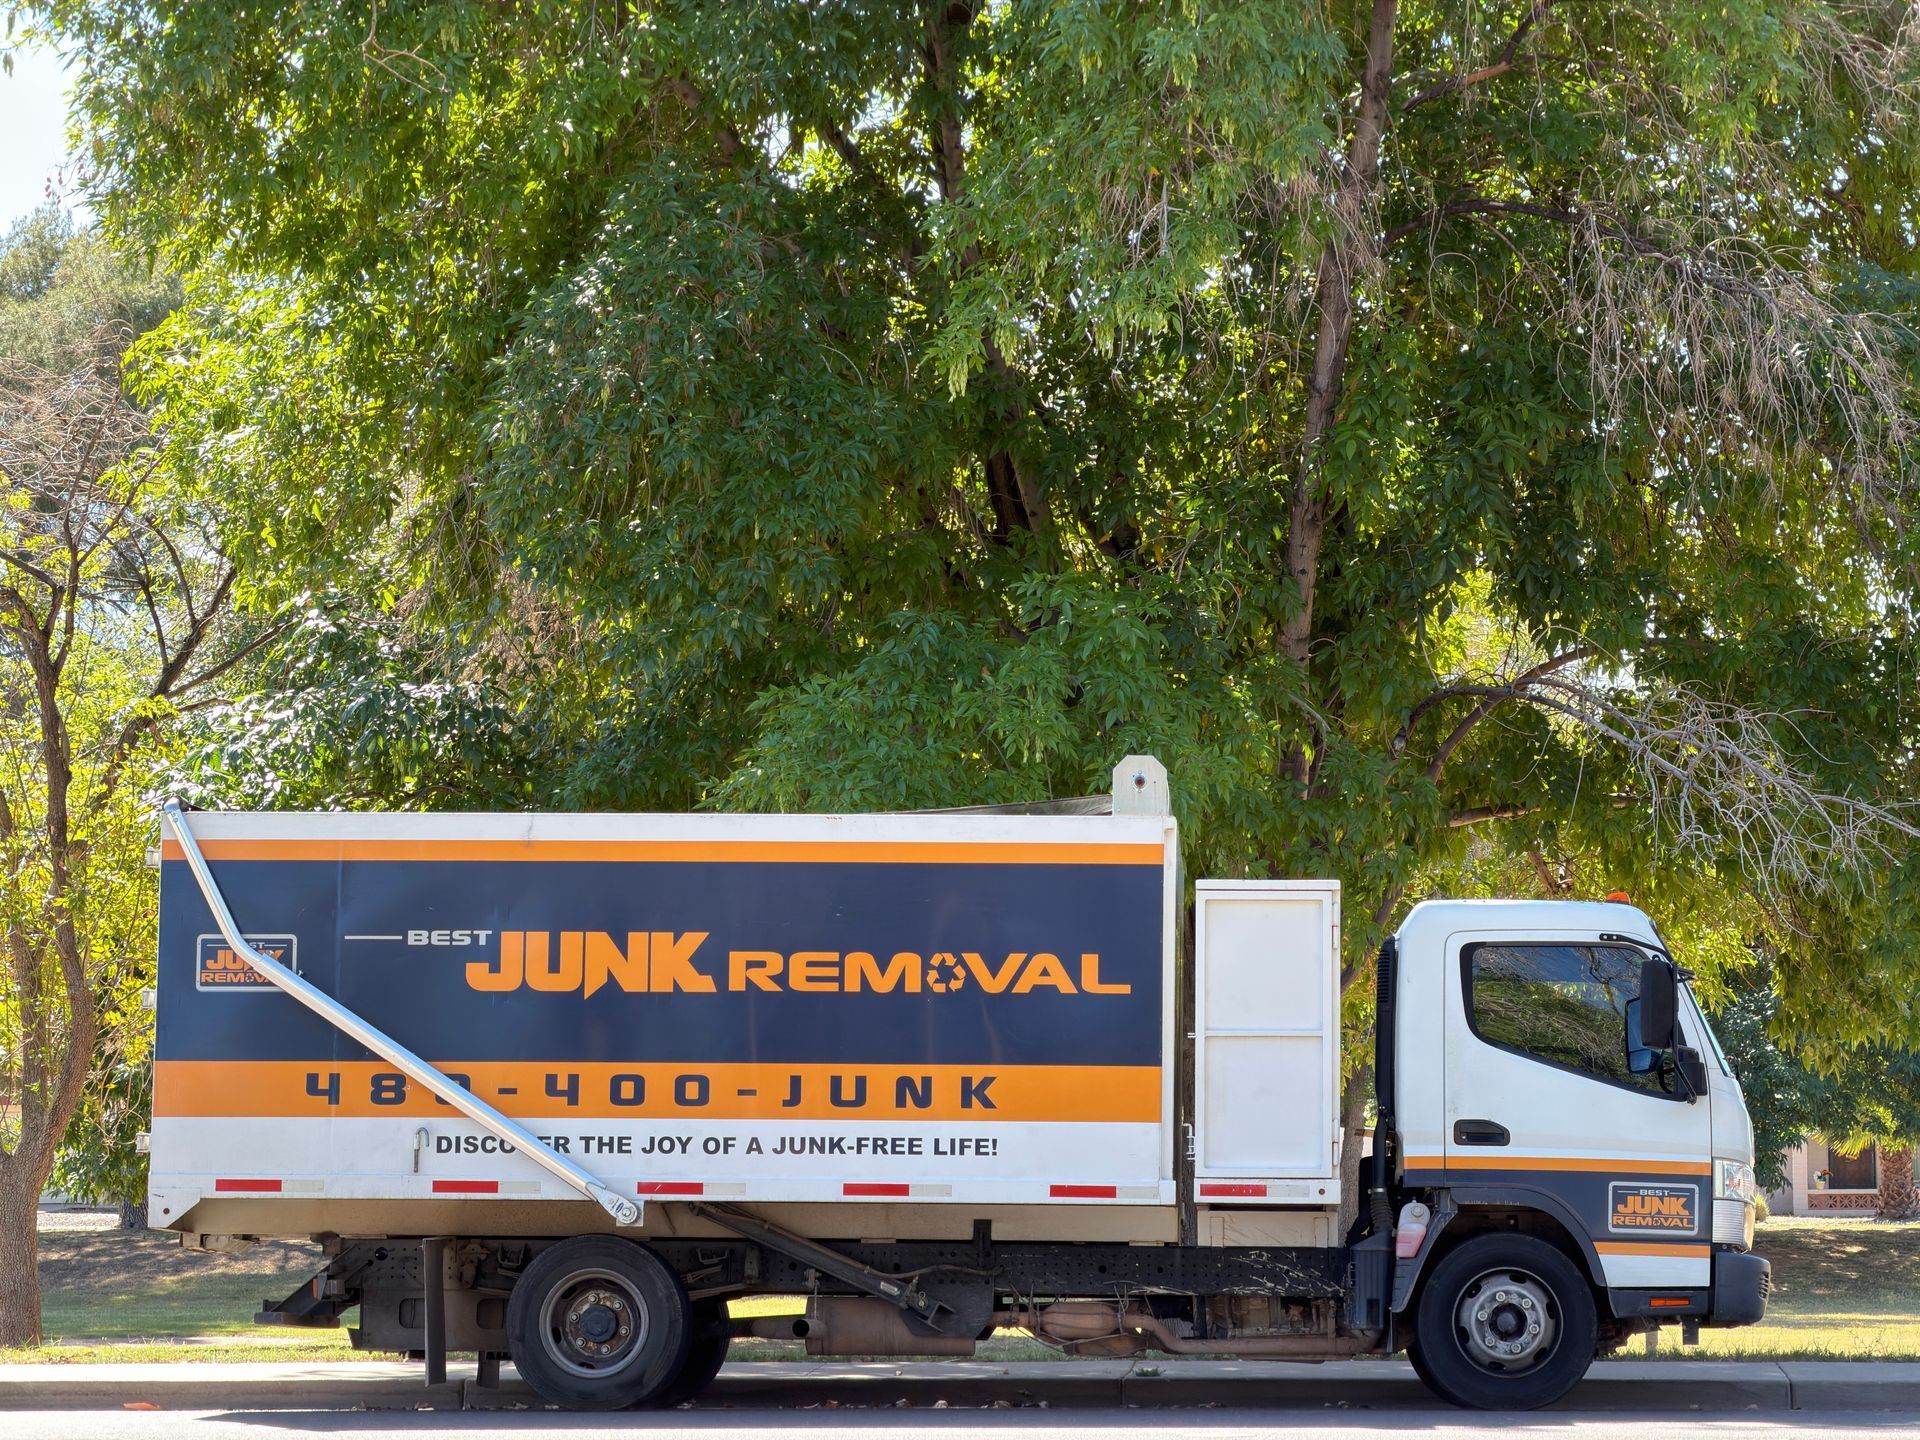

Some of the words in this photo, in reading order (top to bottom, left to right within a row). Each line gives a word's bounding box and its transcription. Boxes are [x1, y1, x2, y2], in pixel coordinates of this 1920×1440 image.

[407, 930, 492, 946] BEST
[465, 930, 717, 999] JUNK
[579, 1136, 632, 1154] THE
[641, 1136, 693, 1154] JOY
[702, 1136, 737, 1155] OF
[745, 1137, 764, 1155] A
[772, 1136, 923, 1155] JUNK-FREE
[933, 1137, 998, 1156] LIFE!
[1639, 1189, 1670, 1197] BEST
[1617, 1196, 1690, 1216] JUNK
